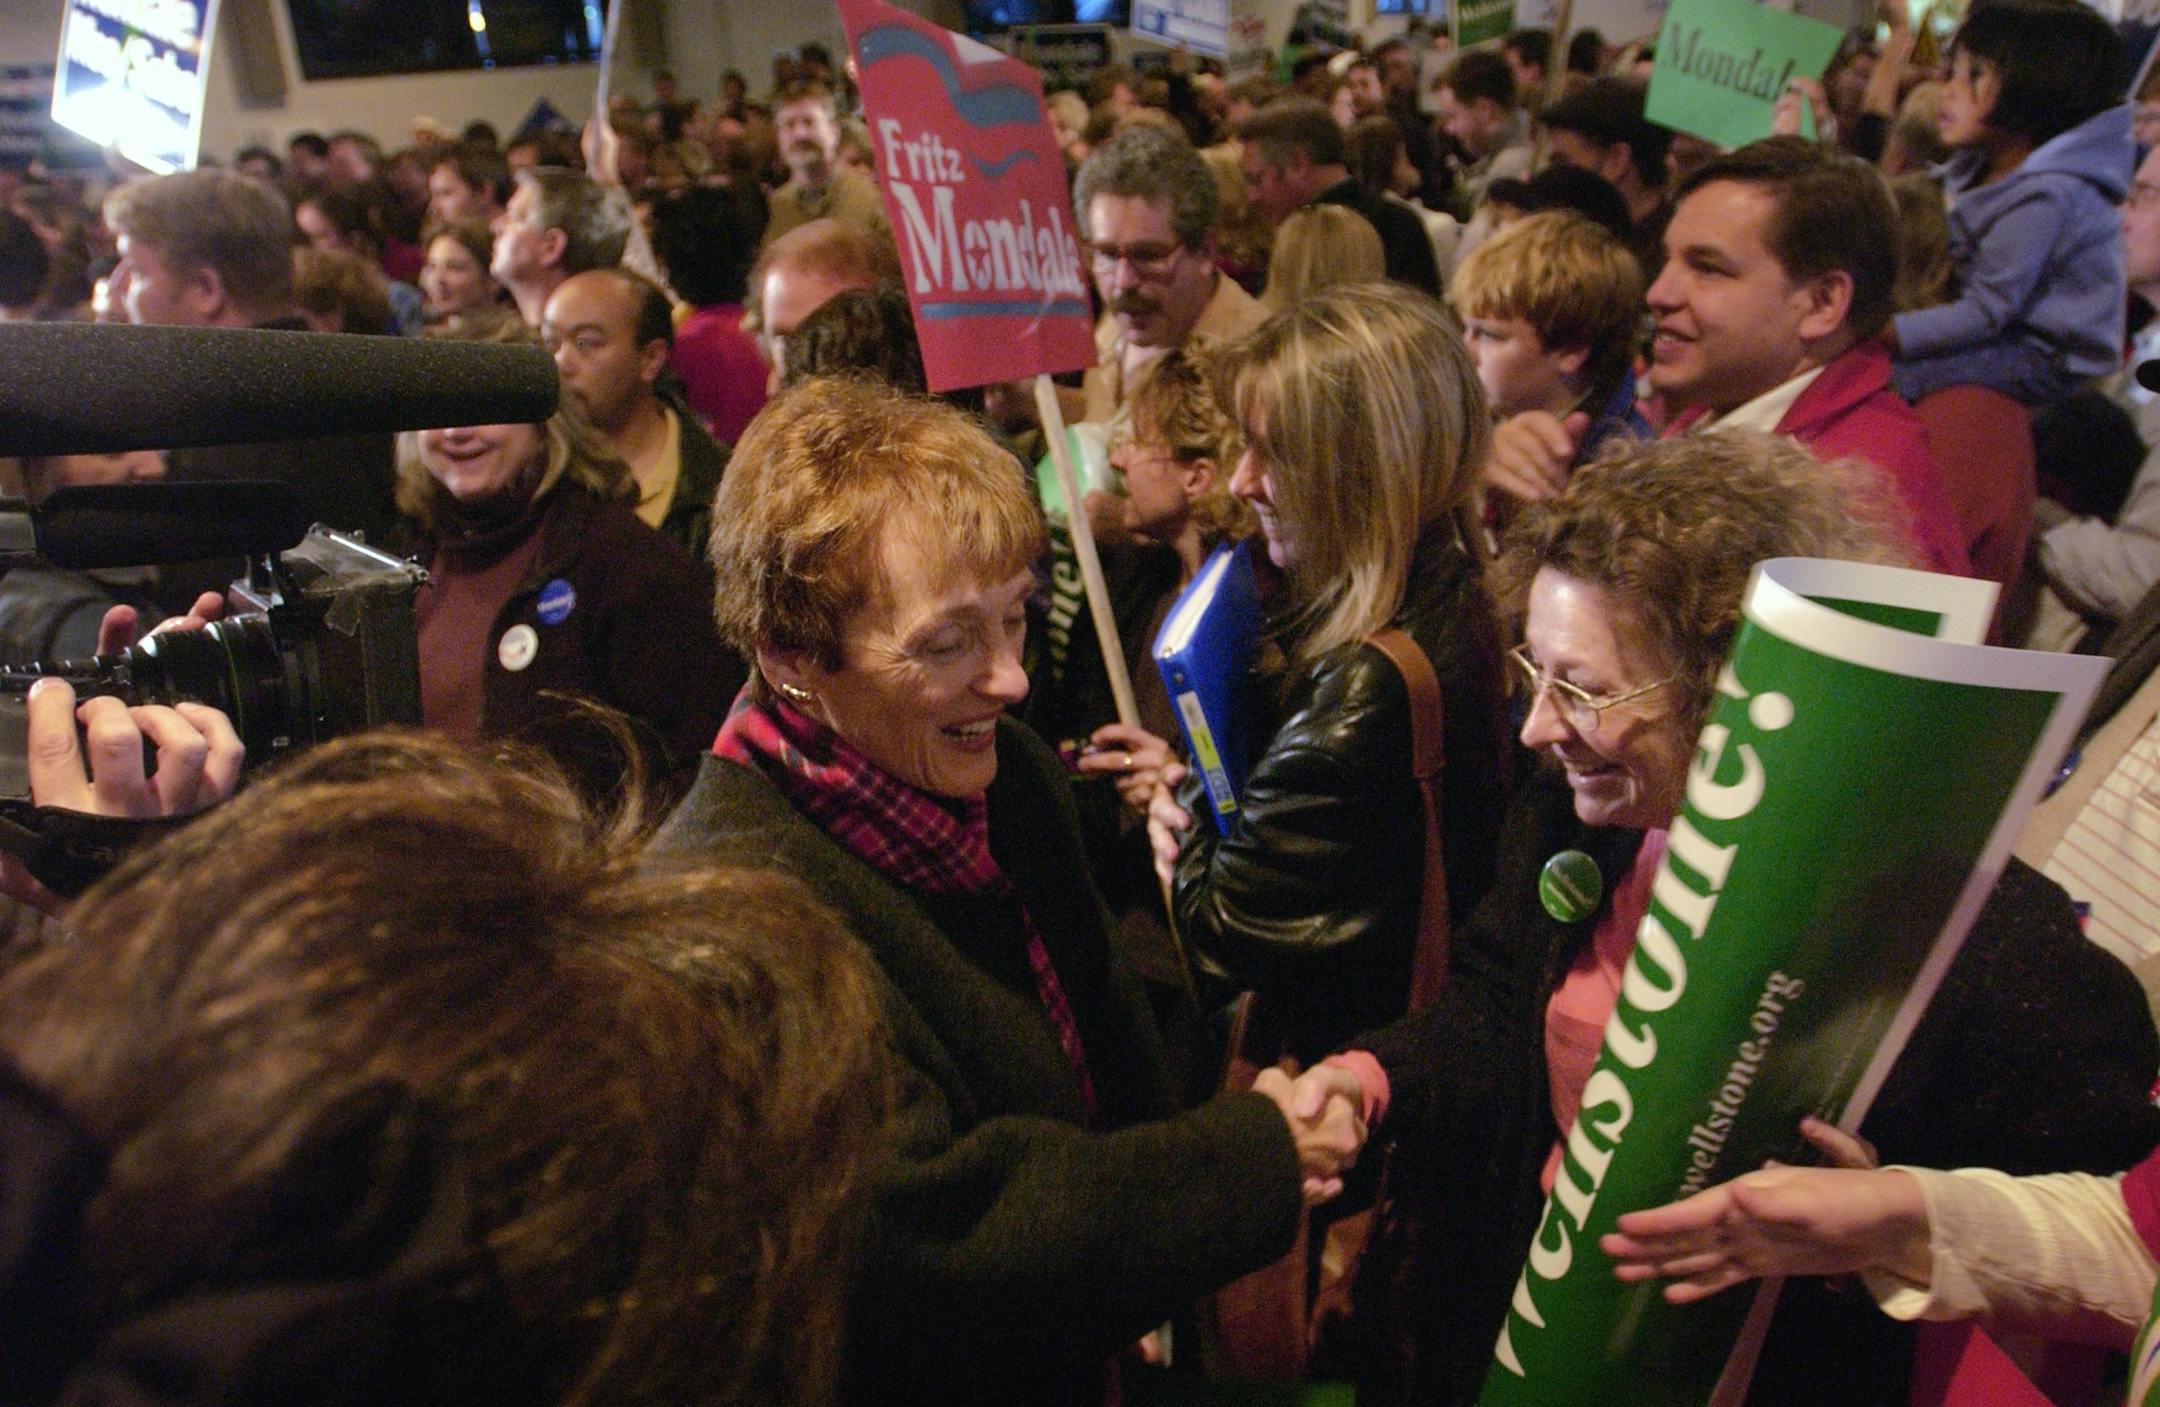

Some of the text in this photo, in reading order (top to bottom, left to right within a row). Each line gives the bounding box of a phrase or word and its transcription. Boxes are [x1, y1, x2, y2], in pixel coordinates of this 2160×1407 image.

[1661, 22, 1796, 102] Mondal
[877, 117, 966, 183] Fritz
[889, 180, 1086, 297] Mondale
